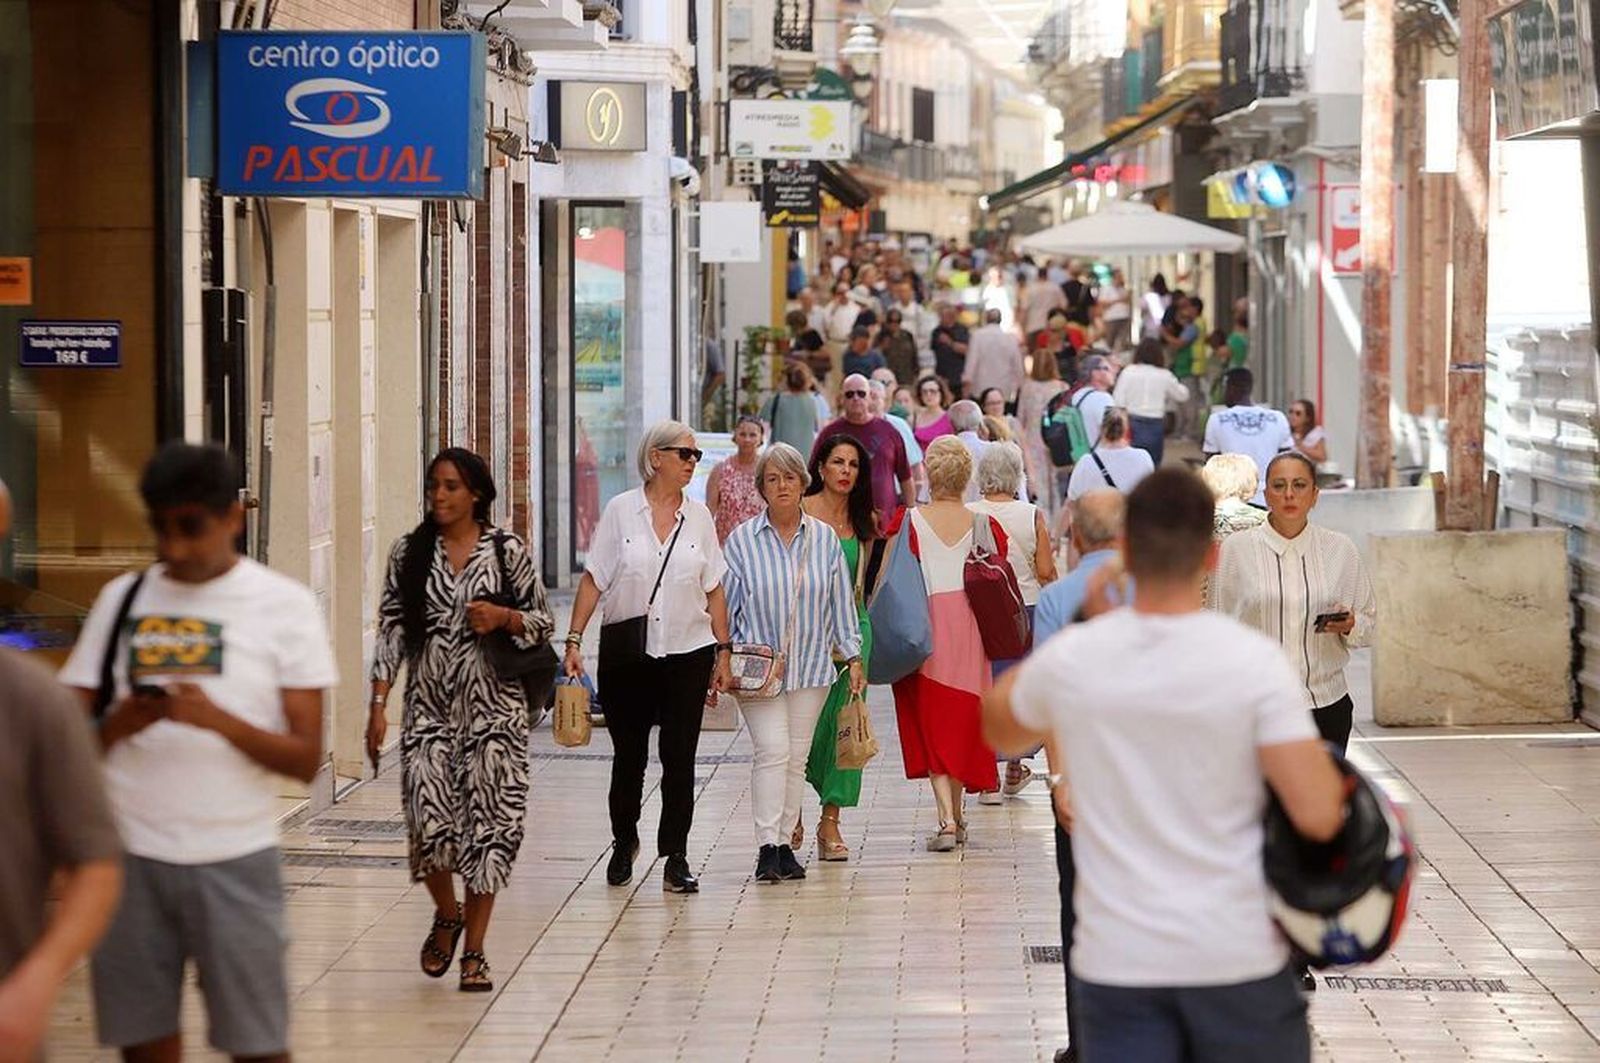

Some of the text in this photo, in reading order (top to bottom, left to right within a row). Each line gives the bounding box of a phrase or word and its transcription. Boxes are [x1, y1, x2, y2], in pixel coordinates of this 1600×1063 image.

[248, 40, 440, 74] centro óptico
[242, 145, 442, 183] PASCUAL
